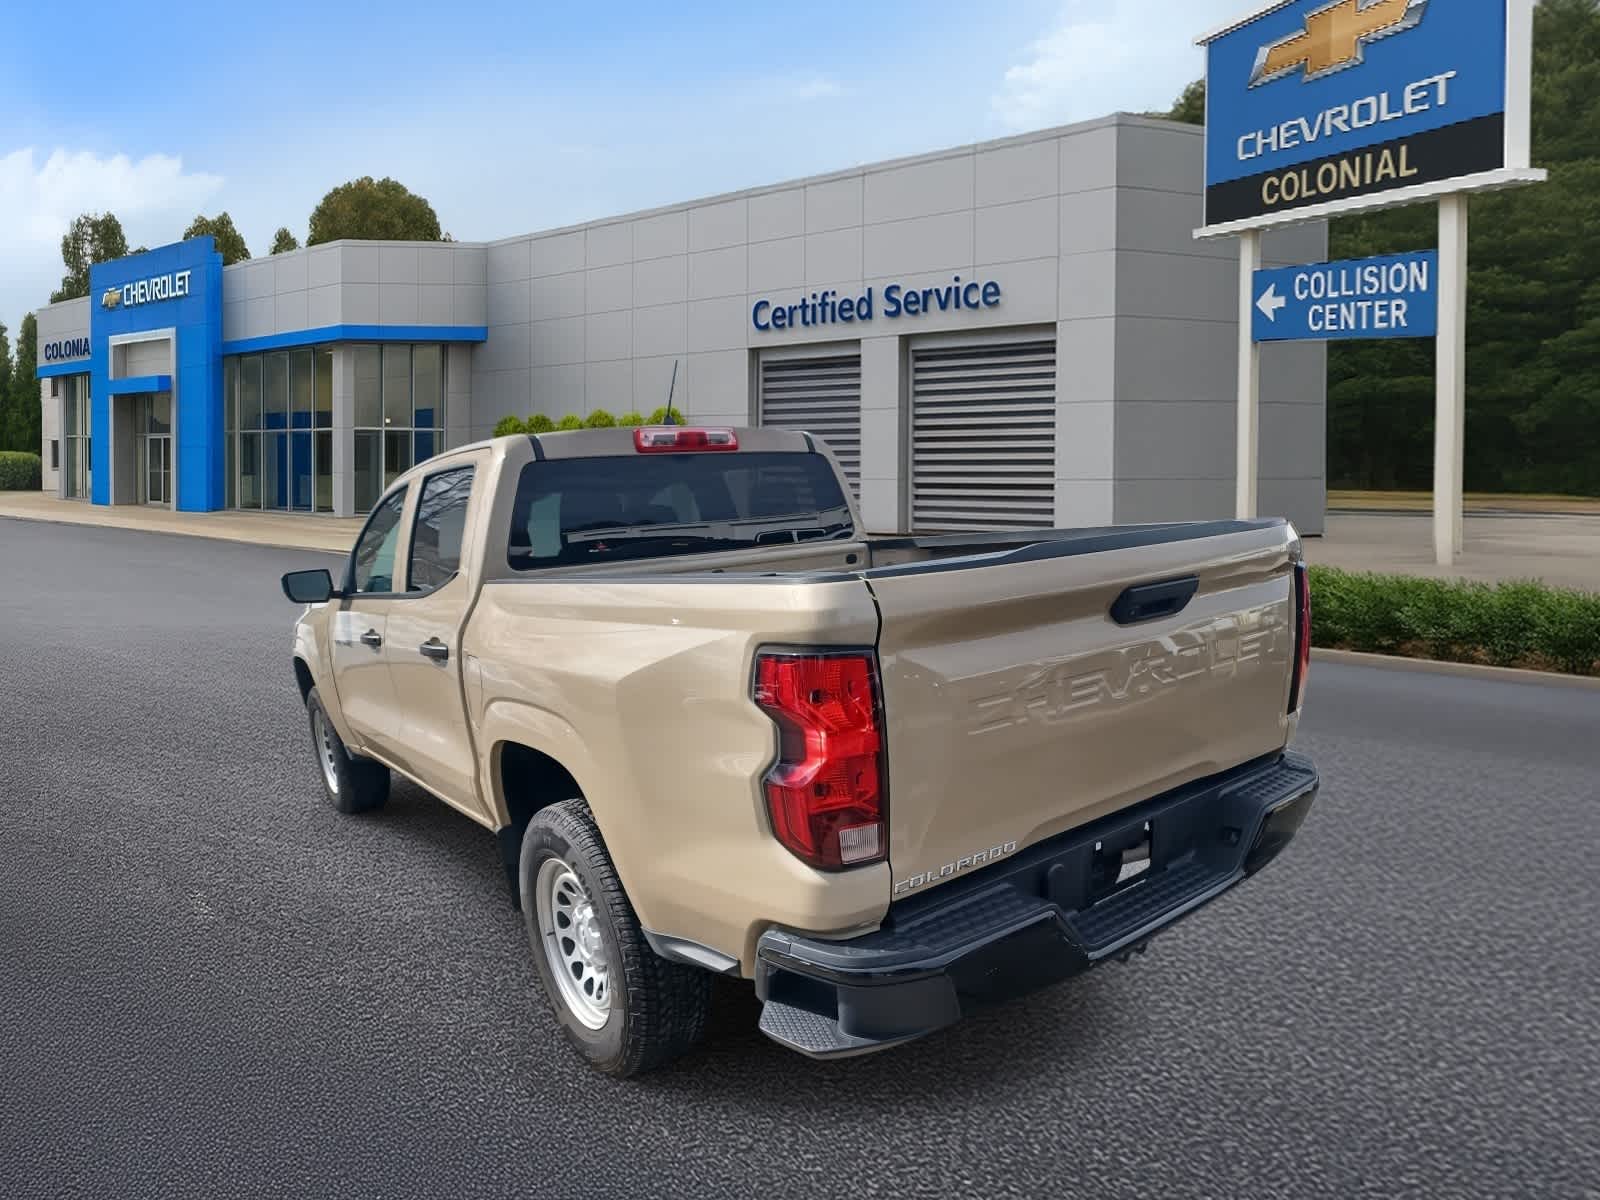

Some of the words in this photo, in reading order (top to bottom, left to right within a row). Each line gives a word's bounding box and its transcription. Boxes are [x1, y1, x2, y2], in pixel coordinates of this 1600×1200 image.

[1237, 71, 1457, 161] CHEVROLET
[1262, 144, 1418, 205] COLONIAL
[123, 271, 190, 305] CHEVROLET
[752, 287, 873, 330] Certified
[883, 276, 1001, 317] Service
[1294, 260, 1428, 300] COLLISION
[1308, 300, 1408, 332] CENTER
[44, 337, 91, 360] COLONIA
[894, 840, 1017, 894] COLORADO
